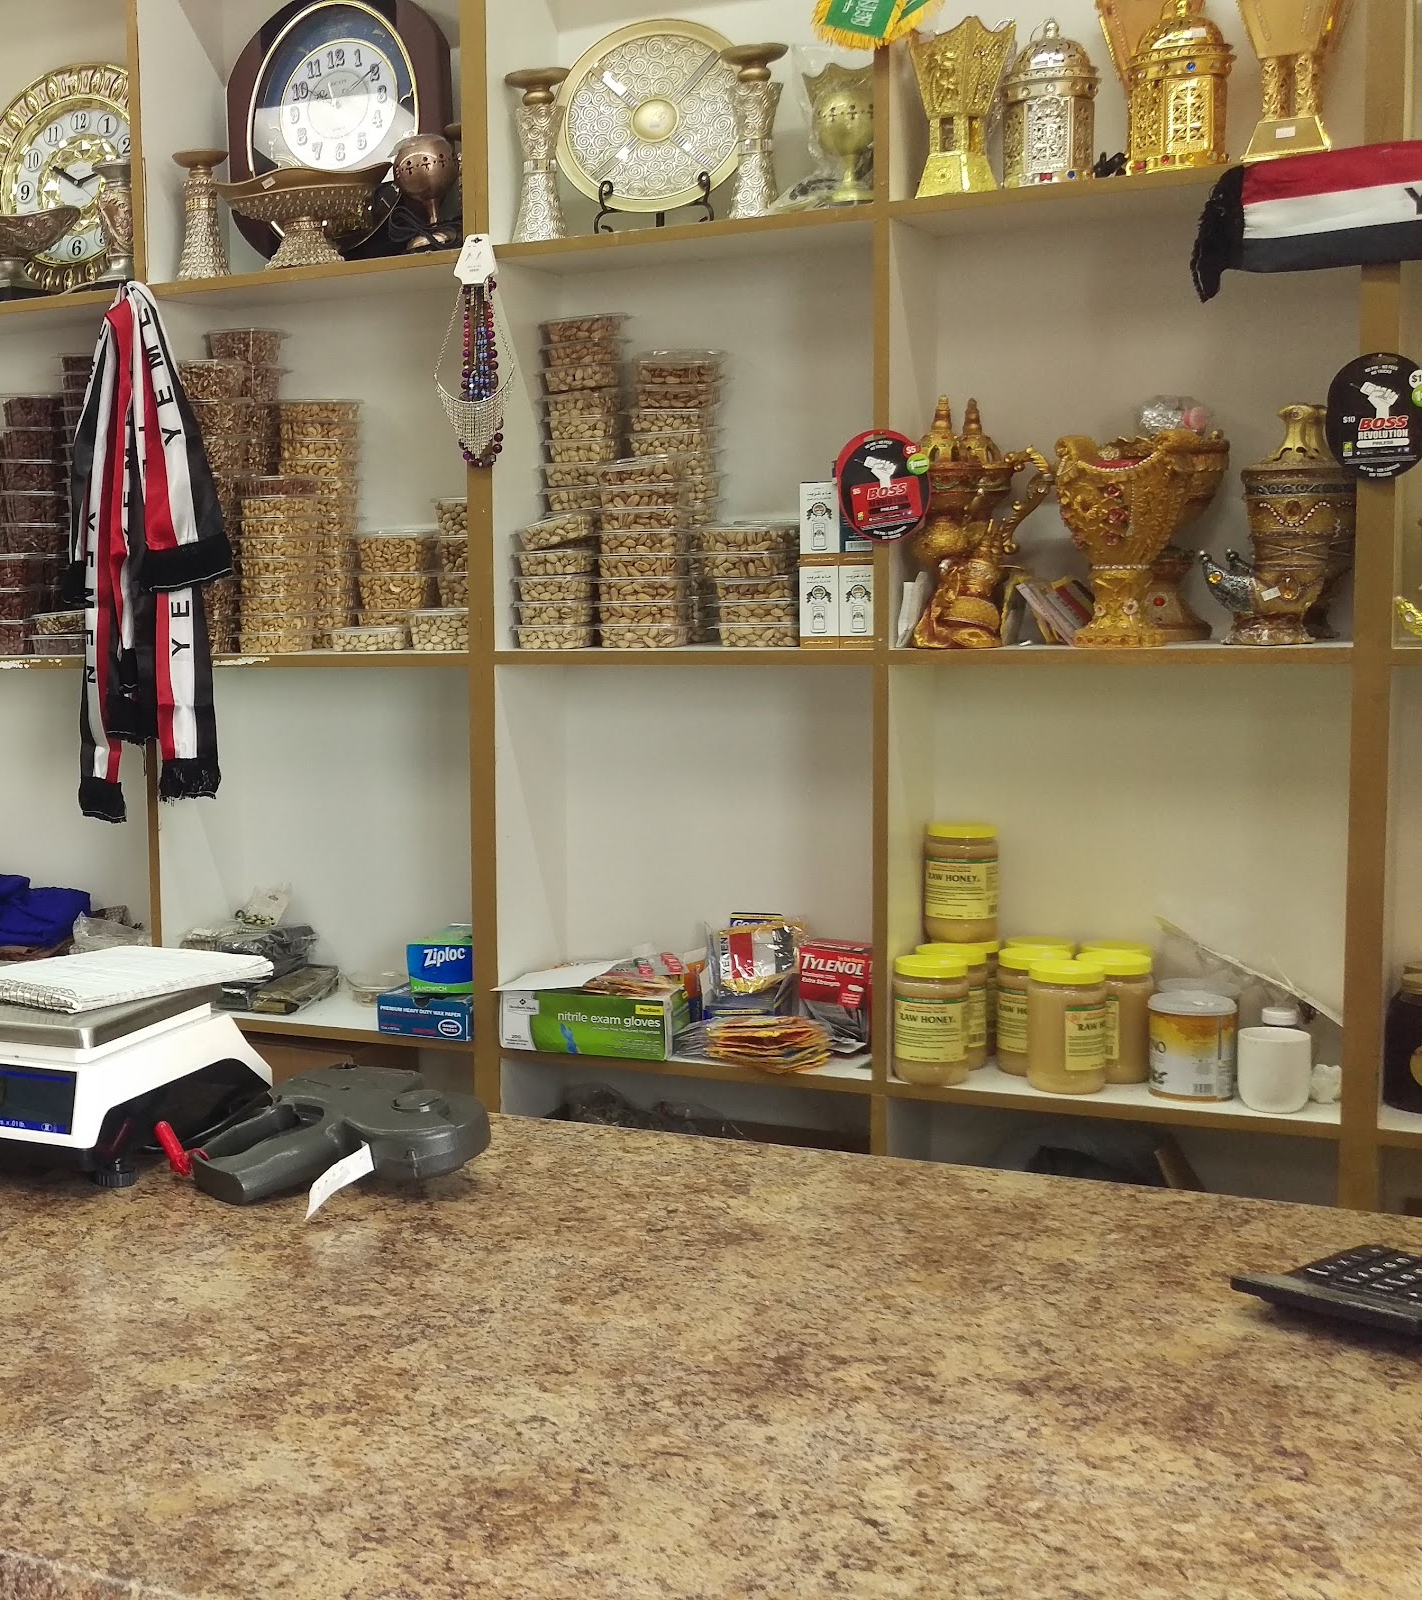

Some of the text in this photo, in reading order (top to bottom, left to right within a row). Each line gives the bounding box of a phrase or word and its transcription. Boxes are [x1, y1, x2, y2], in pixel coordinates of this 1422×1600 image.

[327, 48, 345, 69] 12
[354, 48, 362, 68] 1
[306, 59, 322, 79] 11
[75, 112, 86, 130] 12
[104, 116, 111, 134] 1
[47, 126, 59, 143] 11
[28, 151, 38, 169] 10
[20, 184, 30, 200] 9
[72, 239, 81, 256] 6
[139, 307, 182, 447] YEME
[1411, 374, 1422, 383] $1
[1342, 415, 1356, 424] $10
[1358, 415, 1410, 431] BOSS
[1358, 429, 1409, 440] REVOLUTION
[906, 446, 916, 454] $5
[867, 482, 907, 500] BOSS
[945, 874, 977, 882] HONEY
[423, 946, 466, 968] Ziploc
[801, 953, 864, 976] TYLENOL
[557, 1011, 661, 1028] nitrile exam gloves
[900, 1012, 953, 1024] RAW HONEY
[1077, 1022, 1097, 1032] RAW
